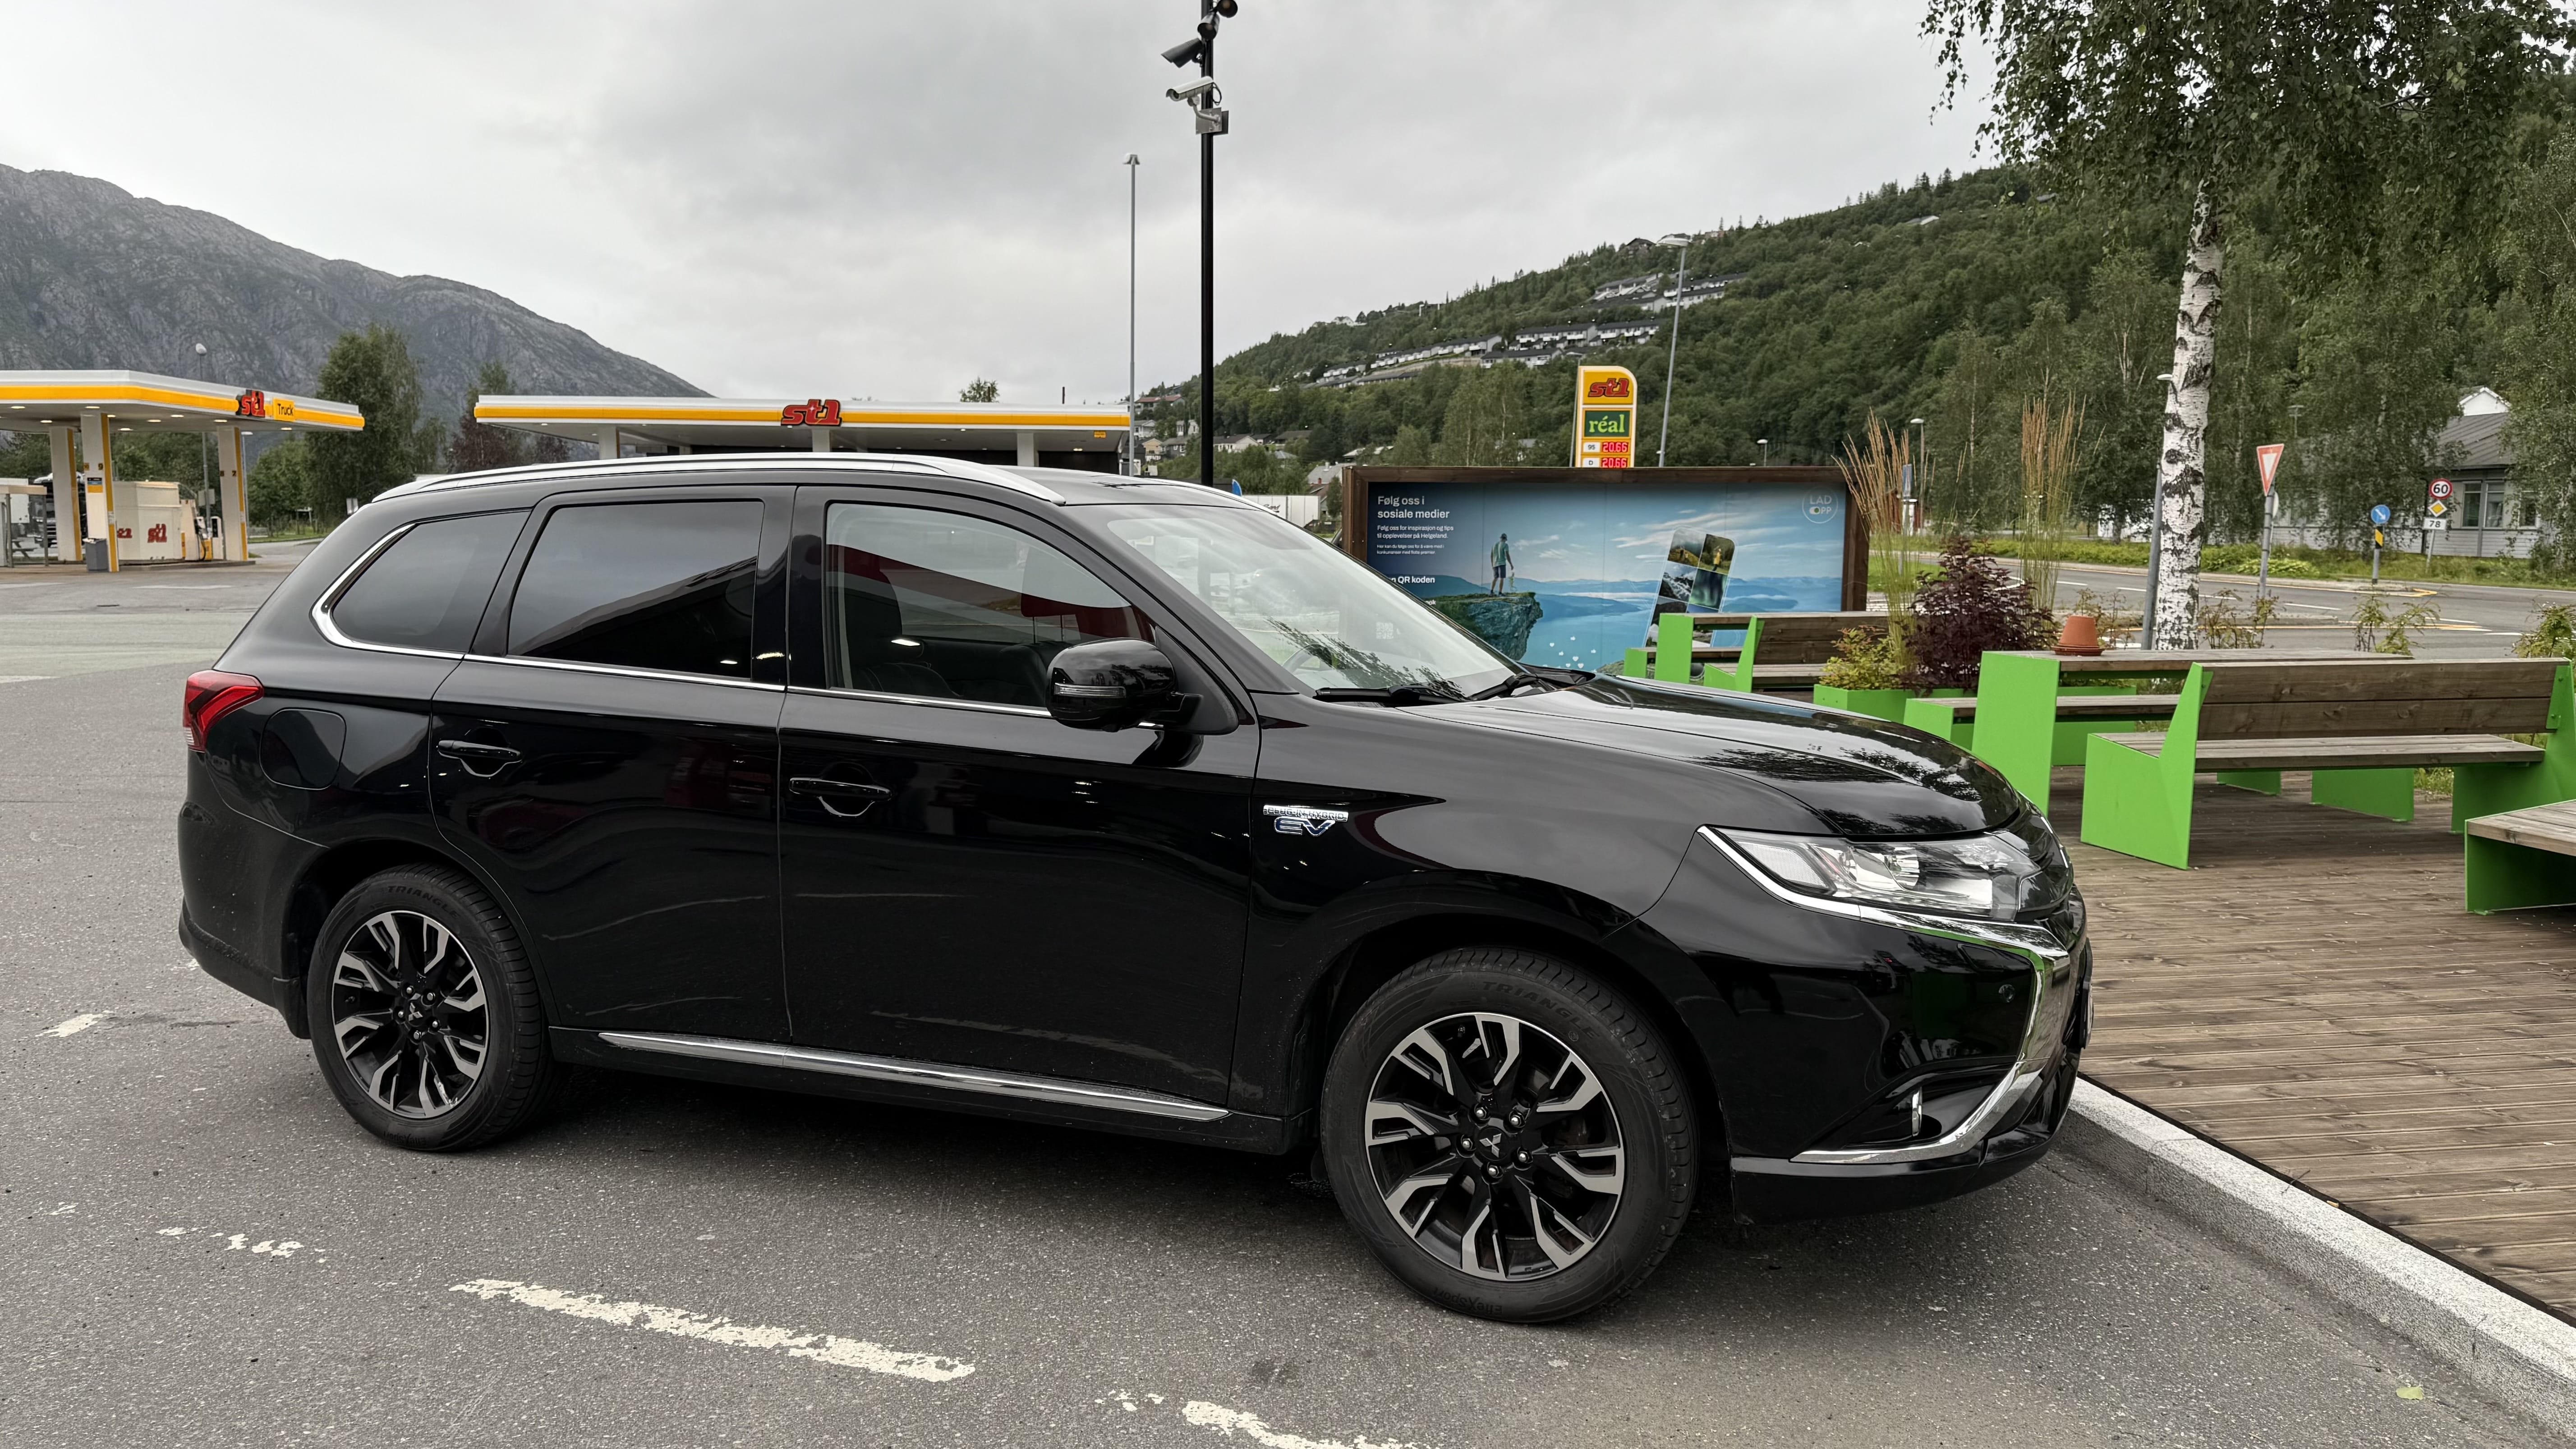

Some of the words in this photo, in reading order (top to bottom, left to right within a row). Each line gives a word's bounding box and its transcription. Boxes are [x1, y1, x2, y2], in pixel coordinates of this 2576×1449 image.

[1588, 378, 1629, 397] st1
[238, 390, 265, 418] st1
[277, 403, 293, 416] Truck
[781, 399, 842, 426] st1
[1589, 414, 1625, 433] réal
[1603, 442, 1628, 452] 20.66
[1602, 458, 1627, 468] 20.66
[2433, 484, 2448, 494] 60
[1378, 496, 1400, 506] Følg
[1422, 496, 1425, 505] i
[1810, 495, 1832, 504] LAD
[1378, 509, 1413, 518] sosiale
[1415, 509, 1450, 518] medier
[117, 528, 132, 538] t1
[147, 524, 167, 543] st1
[1398, 576, 1410, 584] QR
[1308, 810, 1344, 820] HYBRID
[1274, 816, 1335, 837] EV
[388, 885, 461, 920] TRIANGLE
[1482, 981, 1601, 1040] TRIANGLE
